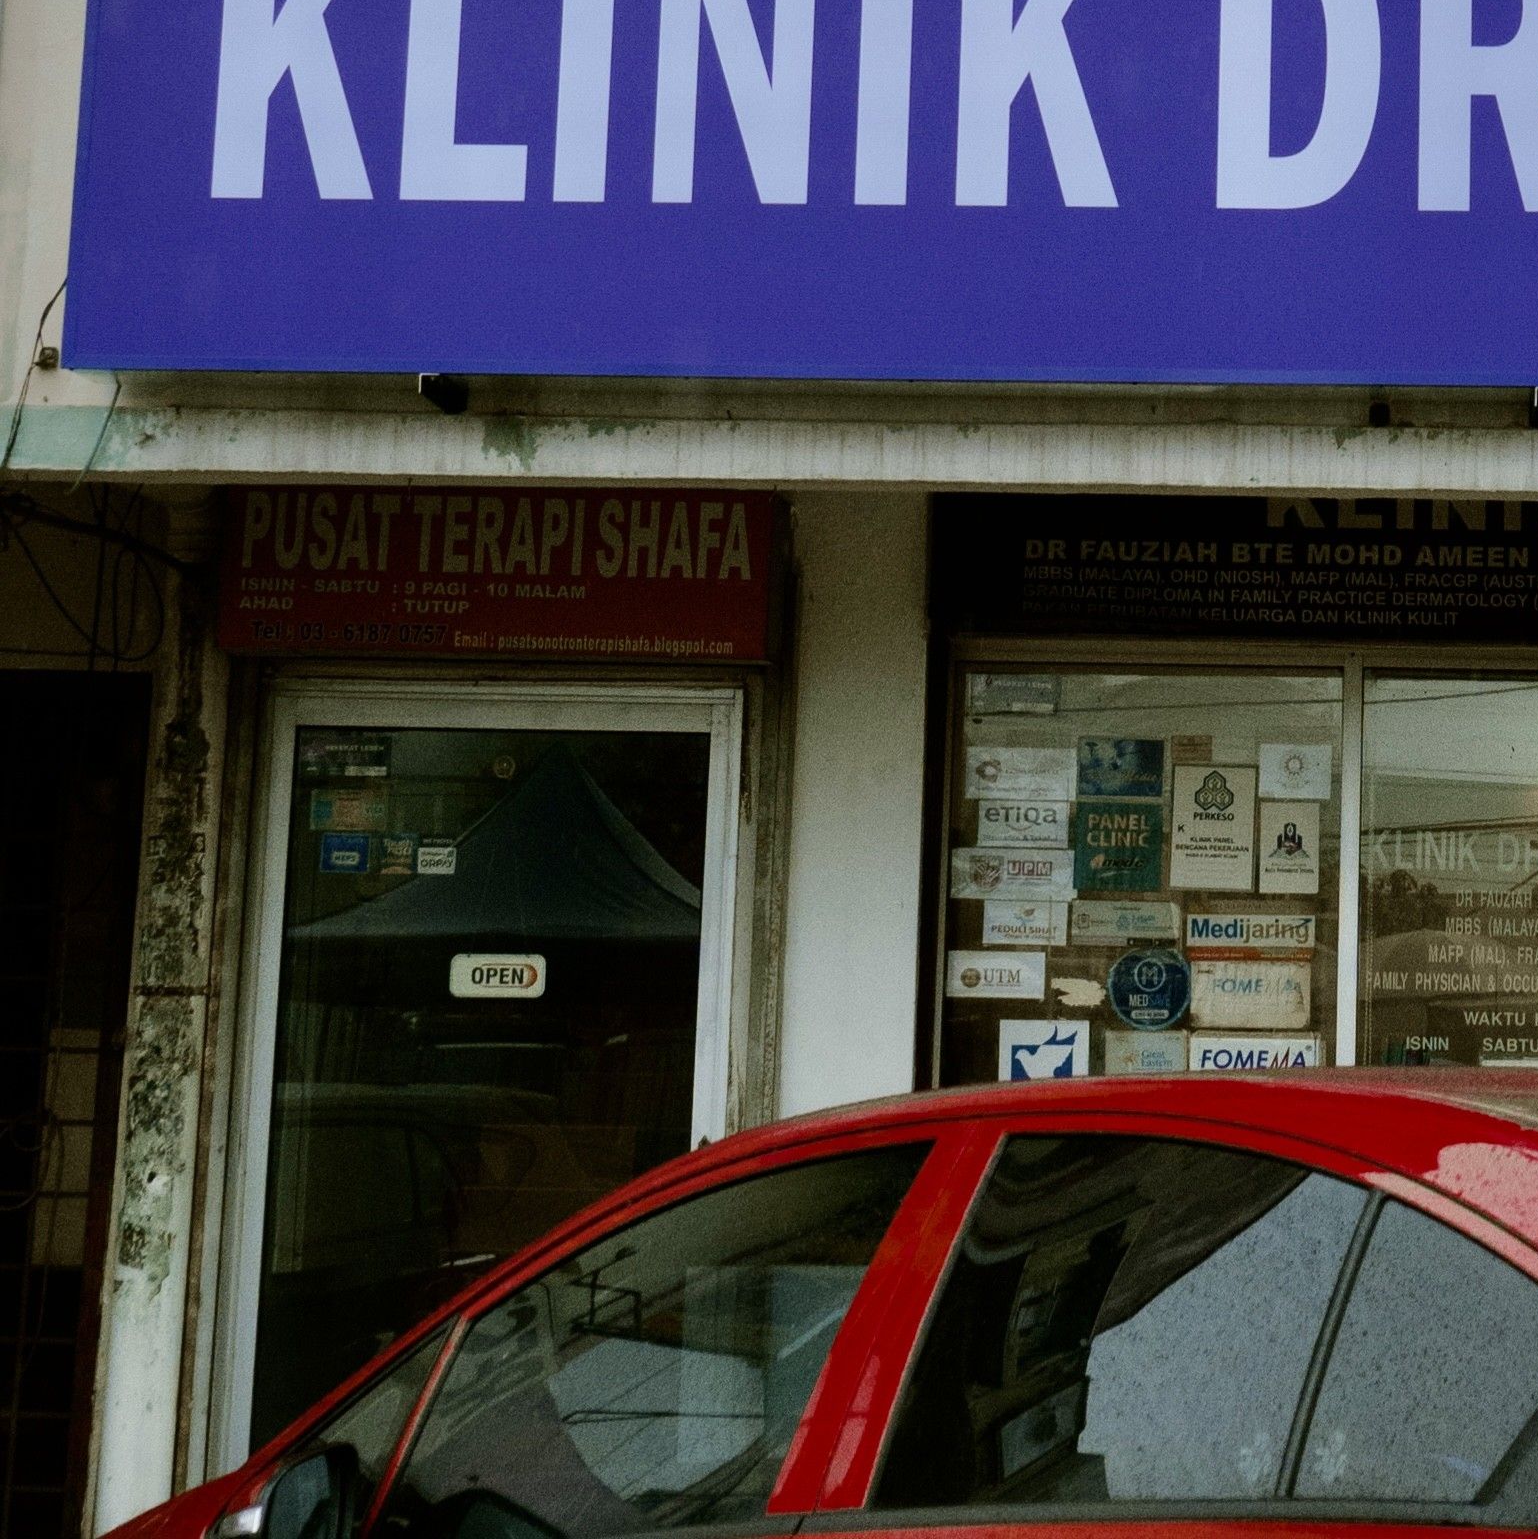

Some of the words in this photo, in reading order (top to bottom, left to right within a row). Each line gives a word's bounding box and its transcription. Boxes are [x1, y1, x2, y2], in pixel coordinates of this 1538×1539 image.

[241, 490, 400, 571] PUSAT
[413, 495, 586, 577] TERAPI
[595, 498, 751, 580] SHAFA
[1024, 539, 1067, 560] DR
[1079, 540, 1218, 563] FAUZIAH
[1231, 542, 1294, 564] BTE
[1307, 543, 1402, 566] MOHD
[1416, 545, 1530, 568] AMEEN
[1023, 566, 1073, 580] MBBS
[1170, 569, 1208, 583] OHD
[1291, 571, 1341, 585] MAFP
[1404, 574, 1477, 588] FRACGP
[240, 577, 296, 592] ISNIN
[313, 579, 381, 594] SABTU
[422, 581, 467, 596] PAGI
[515, 583, 587, 600] MALAM
[1124, 586, 1204, 602] DIPLOMA
[1208, 588, 1224, 603] IN
[1231, 589, 1291, 604] FAMILY
[1297, 590, 1387, 606] PRACTICE
[1392, 592, 1527, 608] DERMATOLOGY
[239, 596, 294, 610] AHAD
[404, 599, 471, 614] TUTUP
[1199, 606, 1297, 622] KELUARGA
[1302, 609, 1339, 623] DAN
[1345, 610, 1407, 625] KLINIK
[1409, 611, 1459, 625] KULIT
[301, 623, 324, 641] 03
[453, 631, 487, 648] Email
[1088, 813, 1151, 831] PANEL
[1193, 812, 1234, 821] PERKESO
[1087, 831, 1151, 848] CLINIC
[1369, 831, 1482, 872] KLINIK
[1007, 860, 1053, 877] UPM
[1455, 891, 1473, 907] DR
[1480, 891, 1532, 908] FAUZIAH
[1190, 918, 1310, 943] Medijaring
[1445, 918, 1481, 935] MBBS
[1428, 945, 1464, 963] MAFP
[471, 967, 524, 984] OPEN
[983, 968, 1021, 984] UTM
[1415, 972, 1481, 991] PHYSICIAN
[1463, 1011, 1526, 1027] WAKTU
[1405, 1036, 1449, 1051] ISNIN
